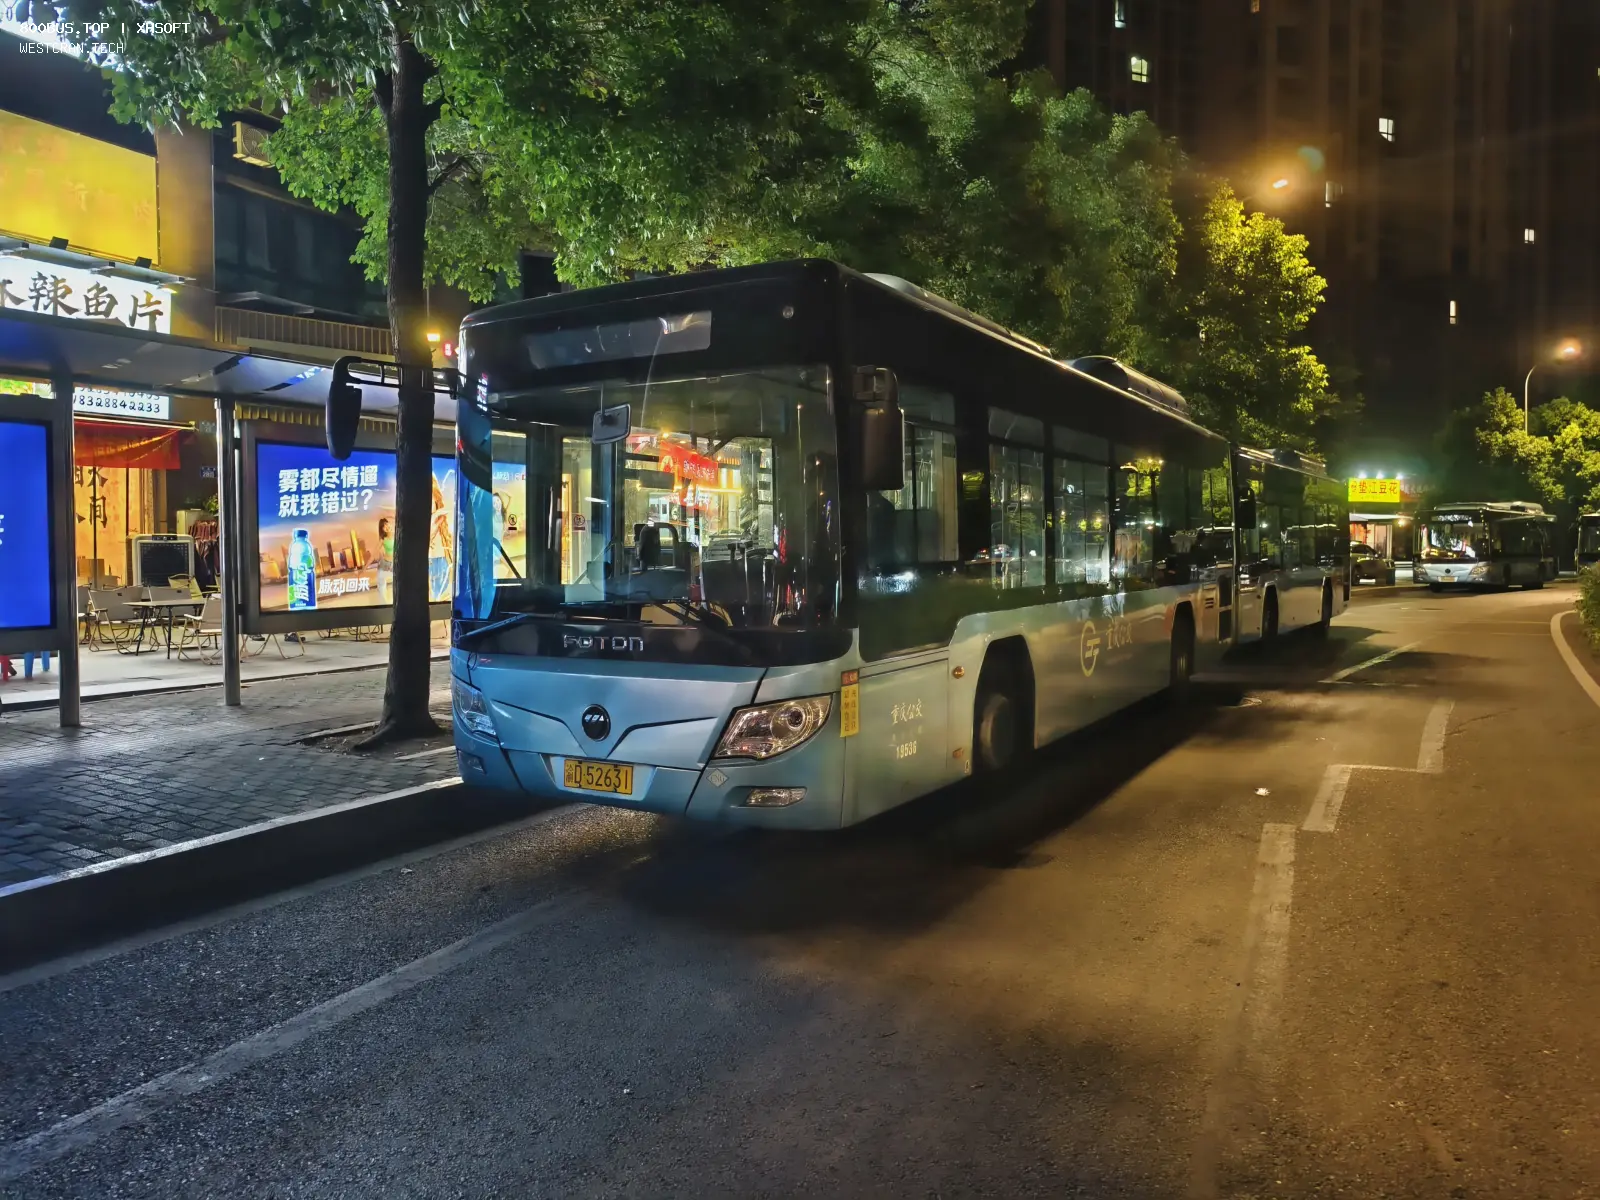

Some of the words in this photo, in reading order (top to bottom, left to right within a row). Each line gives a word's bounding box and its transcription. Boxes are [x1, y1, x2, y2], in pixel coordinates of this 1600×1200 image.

[278, 464, 379, 493] 雾都尽情遛
[318, 576, 371, 597] 脉动回来
[563, 634, 644, 651] FOTON
